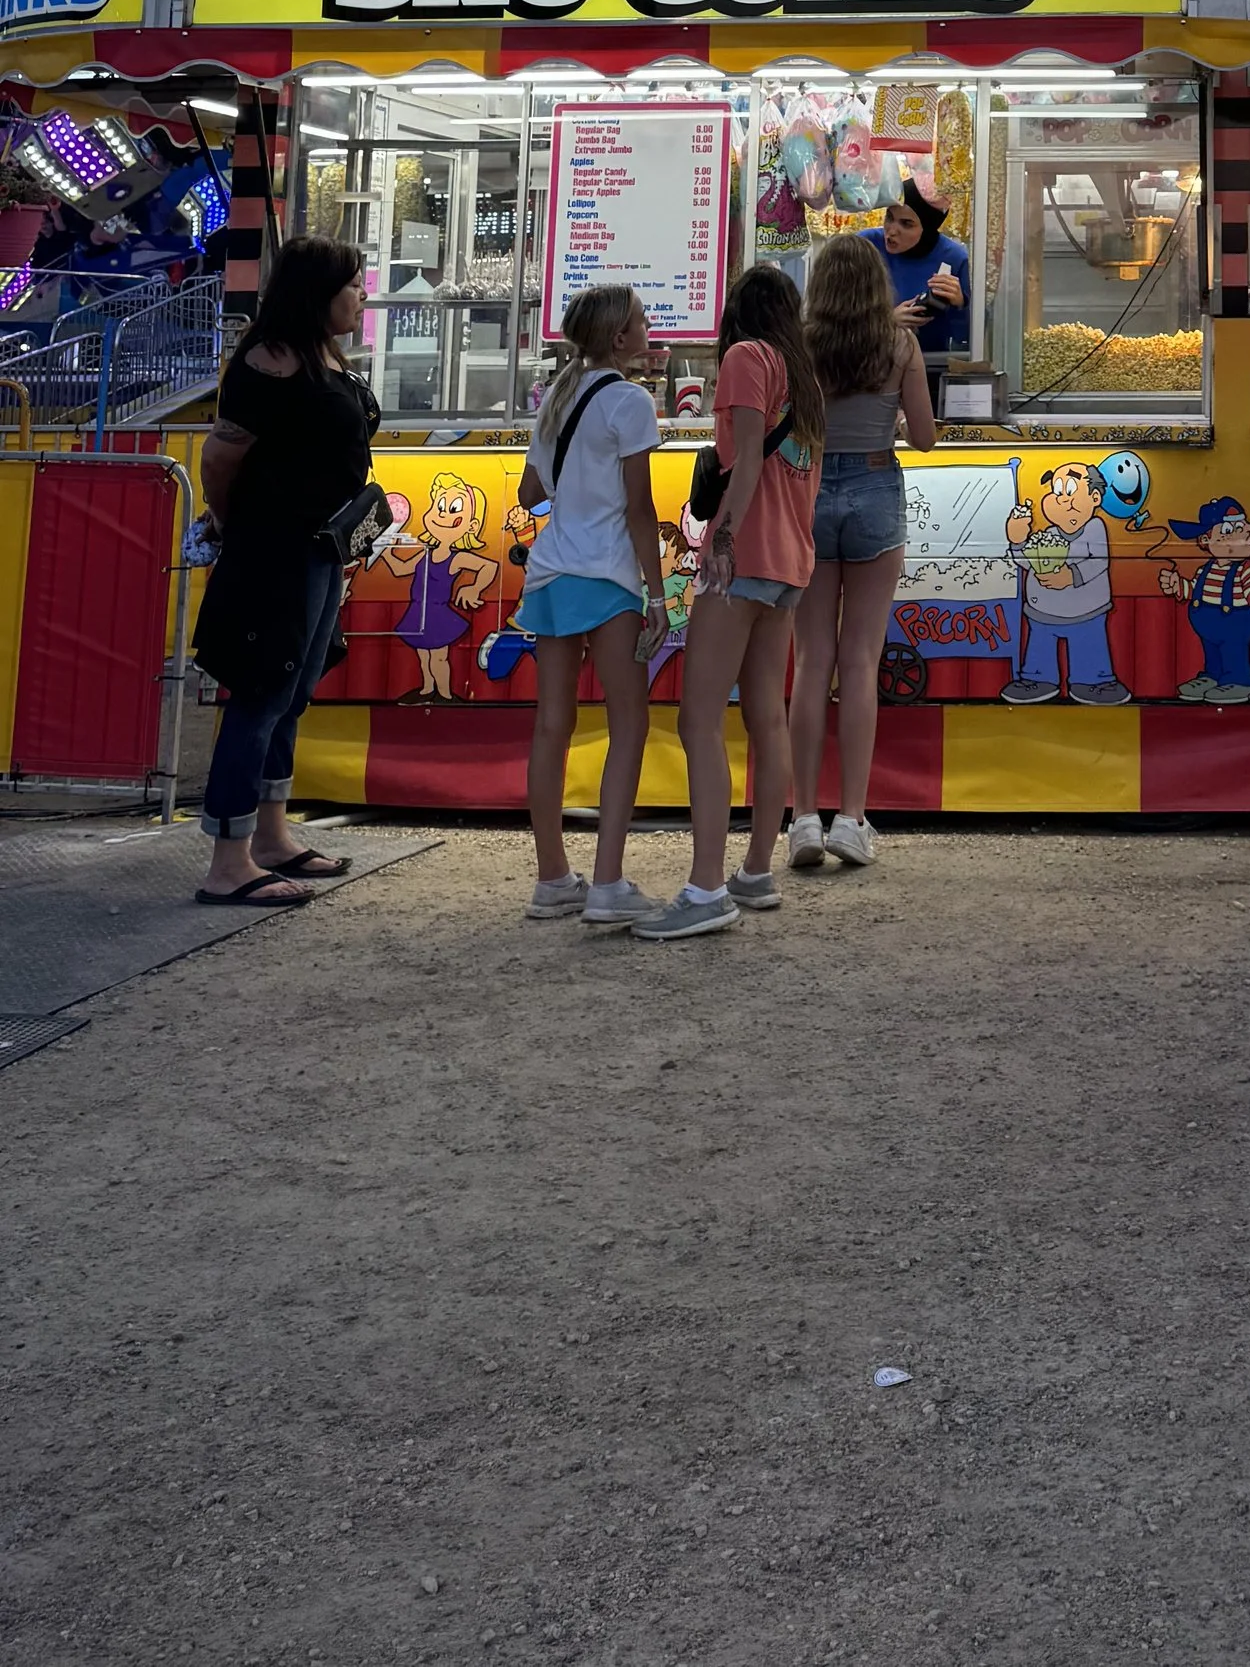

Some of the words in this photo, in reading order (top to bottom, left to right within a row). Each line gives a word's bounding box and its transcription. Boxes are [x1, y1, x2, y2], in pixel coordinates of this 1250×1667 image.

[575, 125, 605, 135] Regular
[606, 125, 621, 135] Bag
[1042, 117, 1091, 143] POP
[575, 135, 600, 144] Jumbo
[602, 135, 616, 145] Bag
[692, 135, 713, 143] 10.00
[574, 145, 606, 154] Extreme
[608, 145, 633, 154] Jumbo
[691, 145, 712, 153] 15.00
[570, 158, 595, 167] Apples
[573, 168, 602, 177] Regular
[604, 168, 627, 176] Candy
[573, 178, 602, 187] Regular
[604, 178, 636, 186] Caramel
[694, 177, 711, 185] 7.00
[572, 188, 594, 197] Fancy
[596, 188, 621, 197] Apples
[567, 199, 596, 208] Lollipop
[692, 198, 710, 206] 5.00
[566, 210, 599, 219] Popcorn
[570, 222, 591, 230] Small
[593, 222, 607, 230] Box
[692, 221, 709, 229] 5.00
[570, 232, 599, 240] Medium
[601, 232, 615, 240] Bag
[691, 231, 709, 239] 7.00
[757, 232, 790, 246] COTTON
[569, 242, 592, 251] Large
[593, 242, 608, 251] Bag
[687, 241, 708, 249] 10.00
[564, 253, 579, 262] Sno
[580, 253, 599, 262] Cone
[690, 253, 708, 261] 5.00
[563, 272, 588, 281] Drinks
[689, 271, 707, 279] 3.00
[689, 281, 706, 290] 4.00
[688, 292, 706, 301] 3.00
[653, 303, 674, 311] Juice
[688, 302, 706, 311] 4.00
[895, 603, 1011, 651] POPCORN
